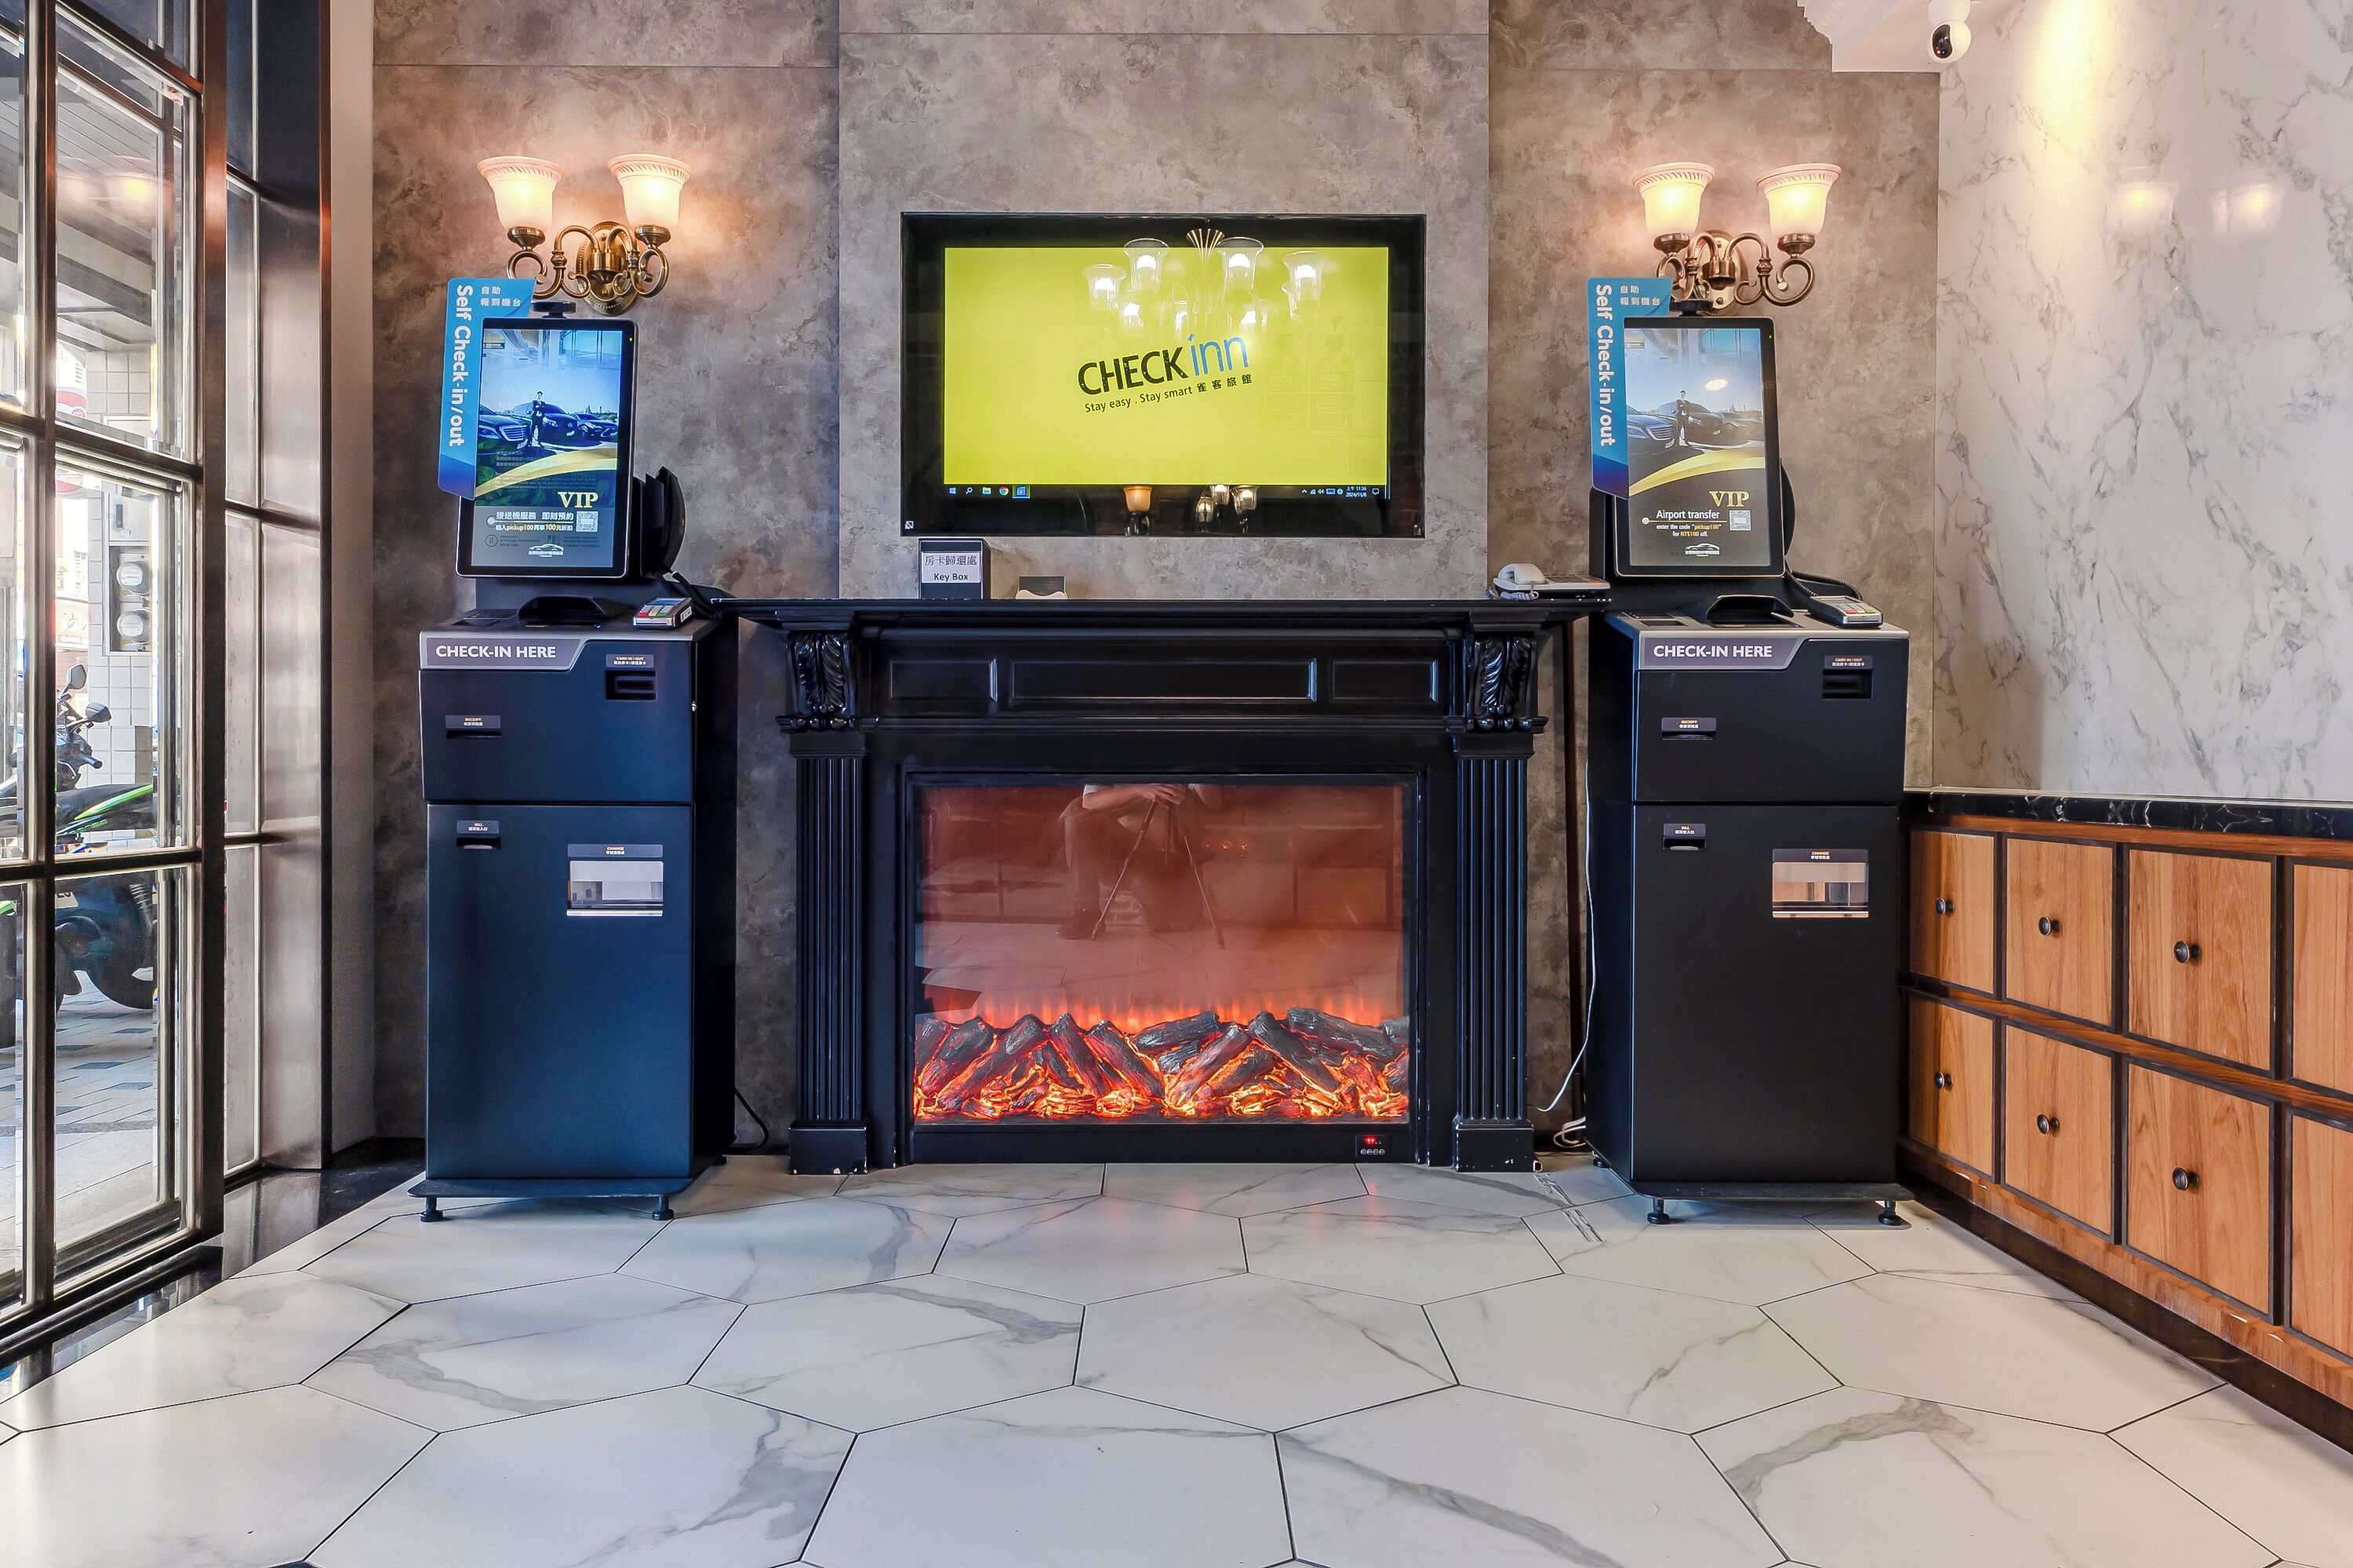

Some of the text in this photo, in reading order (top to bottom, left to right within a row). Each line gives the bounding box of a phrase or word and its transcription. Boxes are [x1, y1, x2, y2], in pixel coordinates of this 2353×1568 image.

[482, 286, 500, 295] 自助
[1620, 285, 1639, 294] 自助
[449, 285, 474, 447] Self Check-in/out
[1078, 347, 1189, 395] CHECK
[1596, 284, 1616, 447] Self Check-in/out
[1196, 373, 1253, 393] 雀客旅館
[1085, 399, 1107, 413] Stay
[1109, 397, 1131, 409] easy
[1139, 392, 1162, 404] Stay
[1164, 385, 1193, 399] smart
[558, 491, 598, 508] VIP
[1708, 490, 1750, 508] VIP
[541, 511, 574, 520] 即刻預約
[1656, 509, 1720, 521] Airport transfer
[924, 555, 977, 566] 房卡歸還處
[933, 573, 969, 582] Key Box
[435, 645, 557, 658] CHECK-IN HERE
[1653, 645, 1773, 658] CHECK-IN HERE
